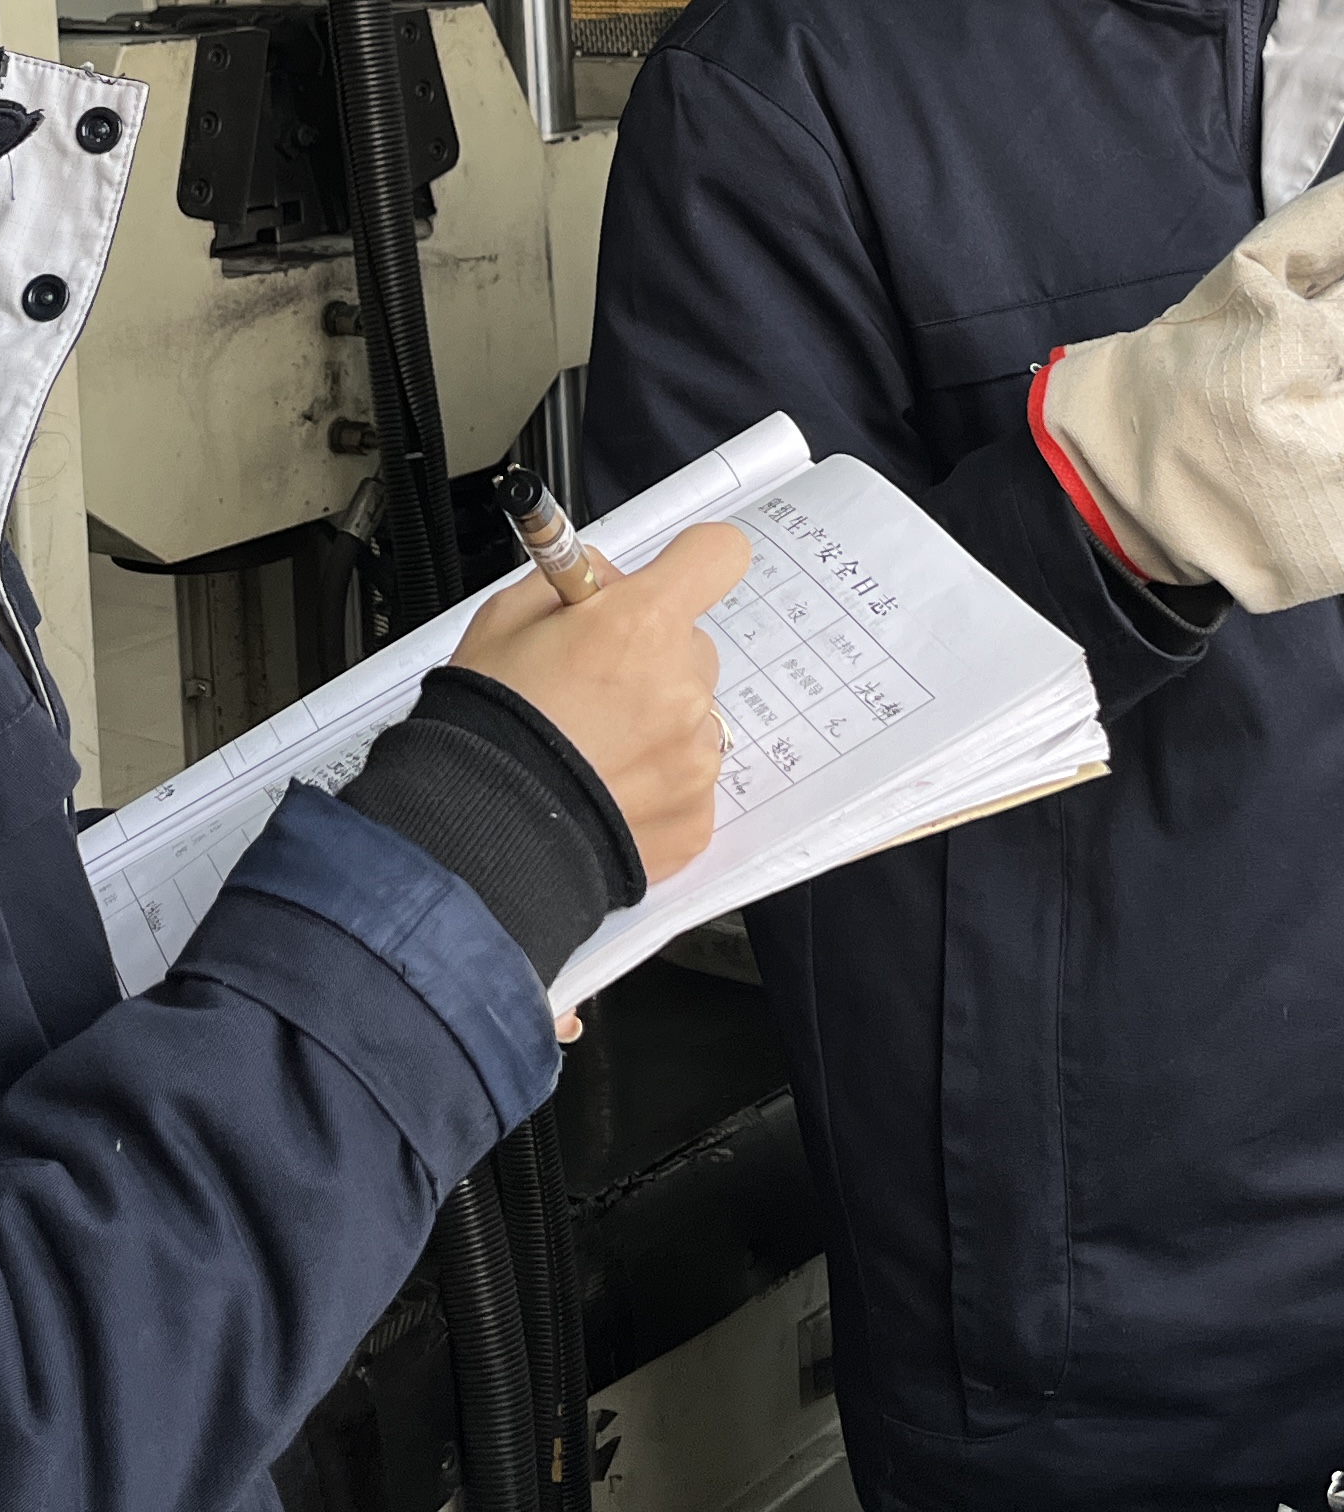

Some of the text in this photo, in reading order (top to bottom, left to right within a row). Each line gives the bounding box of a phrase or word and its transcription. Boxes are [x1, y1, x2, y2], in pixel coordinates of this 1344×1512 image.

[828, 634, 864, 666] 主持人
[737, 684, 779, 727] 掌握情况
